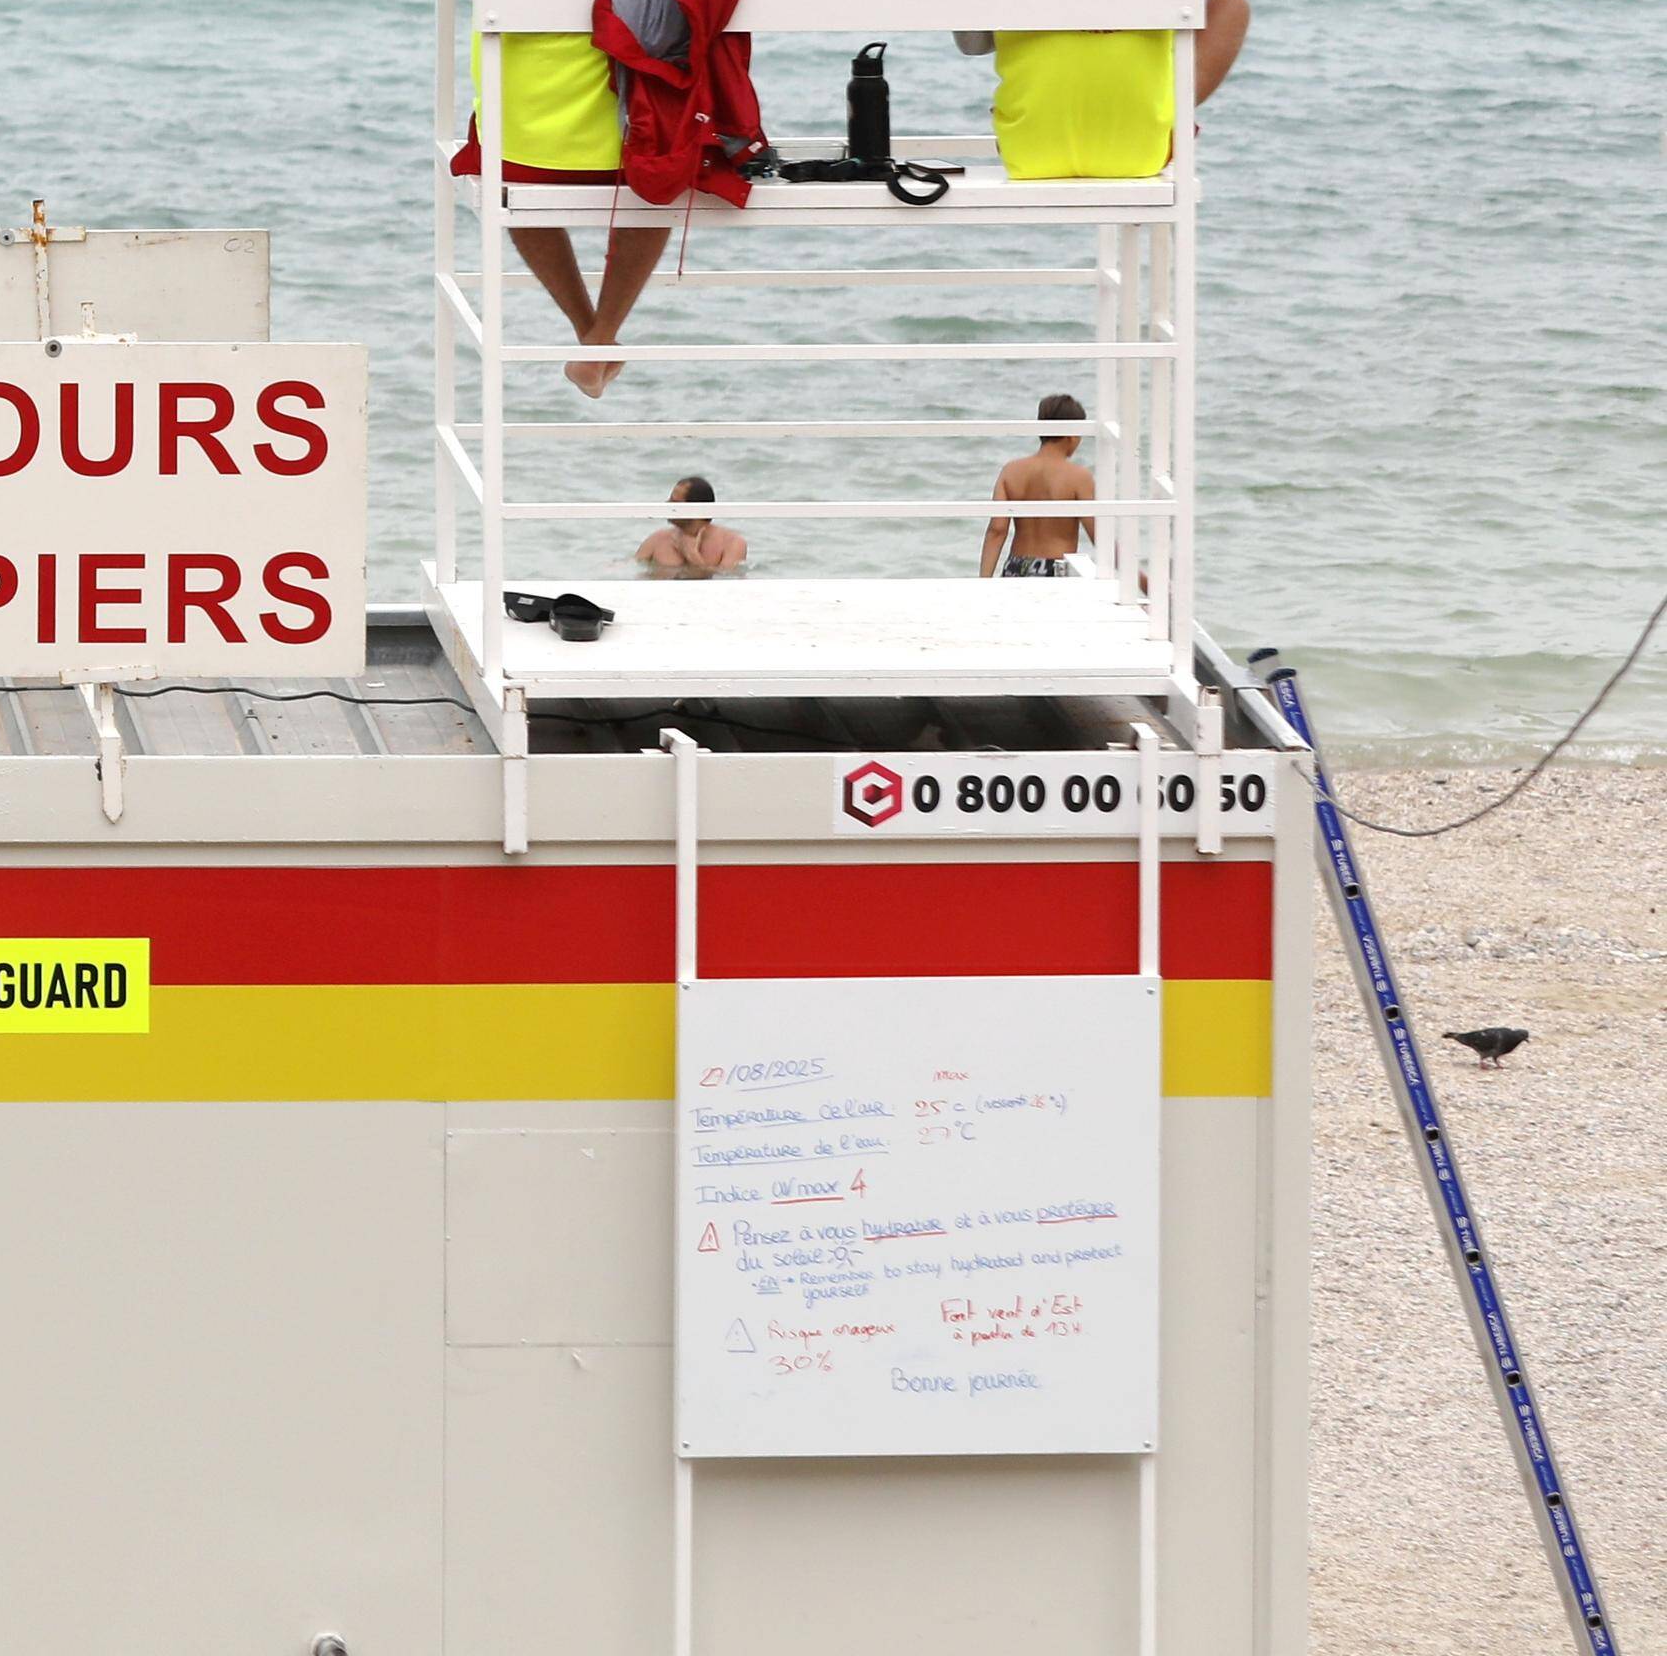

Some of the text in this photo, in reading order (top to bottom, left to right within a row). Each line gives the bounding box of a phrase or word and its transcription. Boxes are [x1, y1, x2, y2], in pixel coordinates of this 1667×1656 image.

[912, 774, 940, 813] 0
[956, 774, 1046, 813] 800
[1062, 774, 1121, 813] 00
[814, 1139, 833, 1156] de
[695, 1185, 763, 1204] Indice
[849, 1168, 868, 1199] 4
[733, 1219, 794, 1247] Pensez
[799, 1225, 816, 1242] à
[817, 1226, 857, 1241] vous
[977, 1209, 992, 1226] à
[994, 1206, 1034, 1225] vous
[735, 1248, 763, 1272] du
[883, 1263, 902, 1279] to
[906, 1259, 942, 1278] stay
[950, 1252, 1025, 1278] hydrated
[1031, 1246, 1062, 1265] and
[1064, 1244, 1124, 1268] protect
[987, 1294, 1025, 1319] vent
[768, 1349, 834, 1376] 30%
[890, 1367, 1043, 1397] Bonne journée
